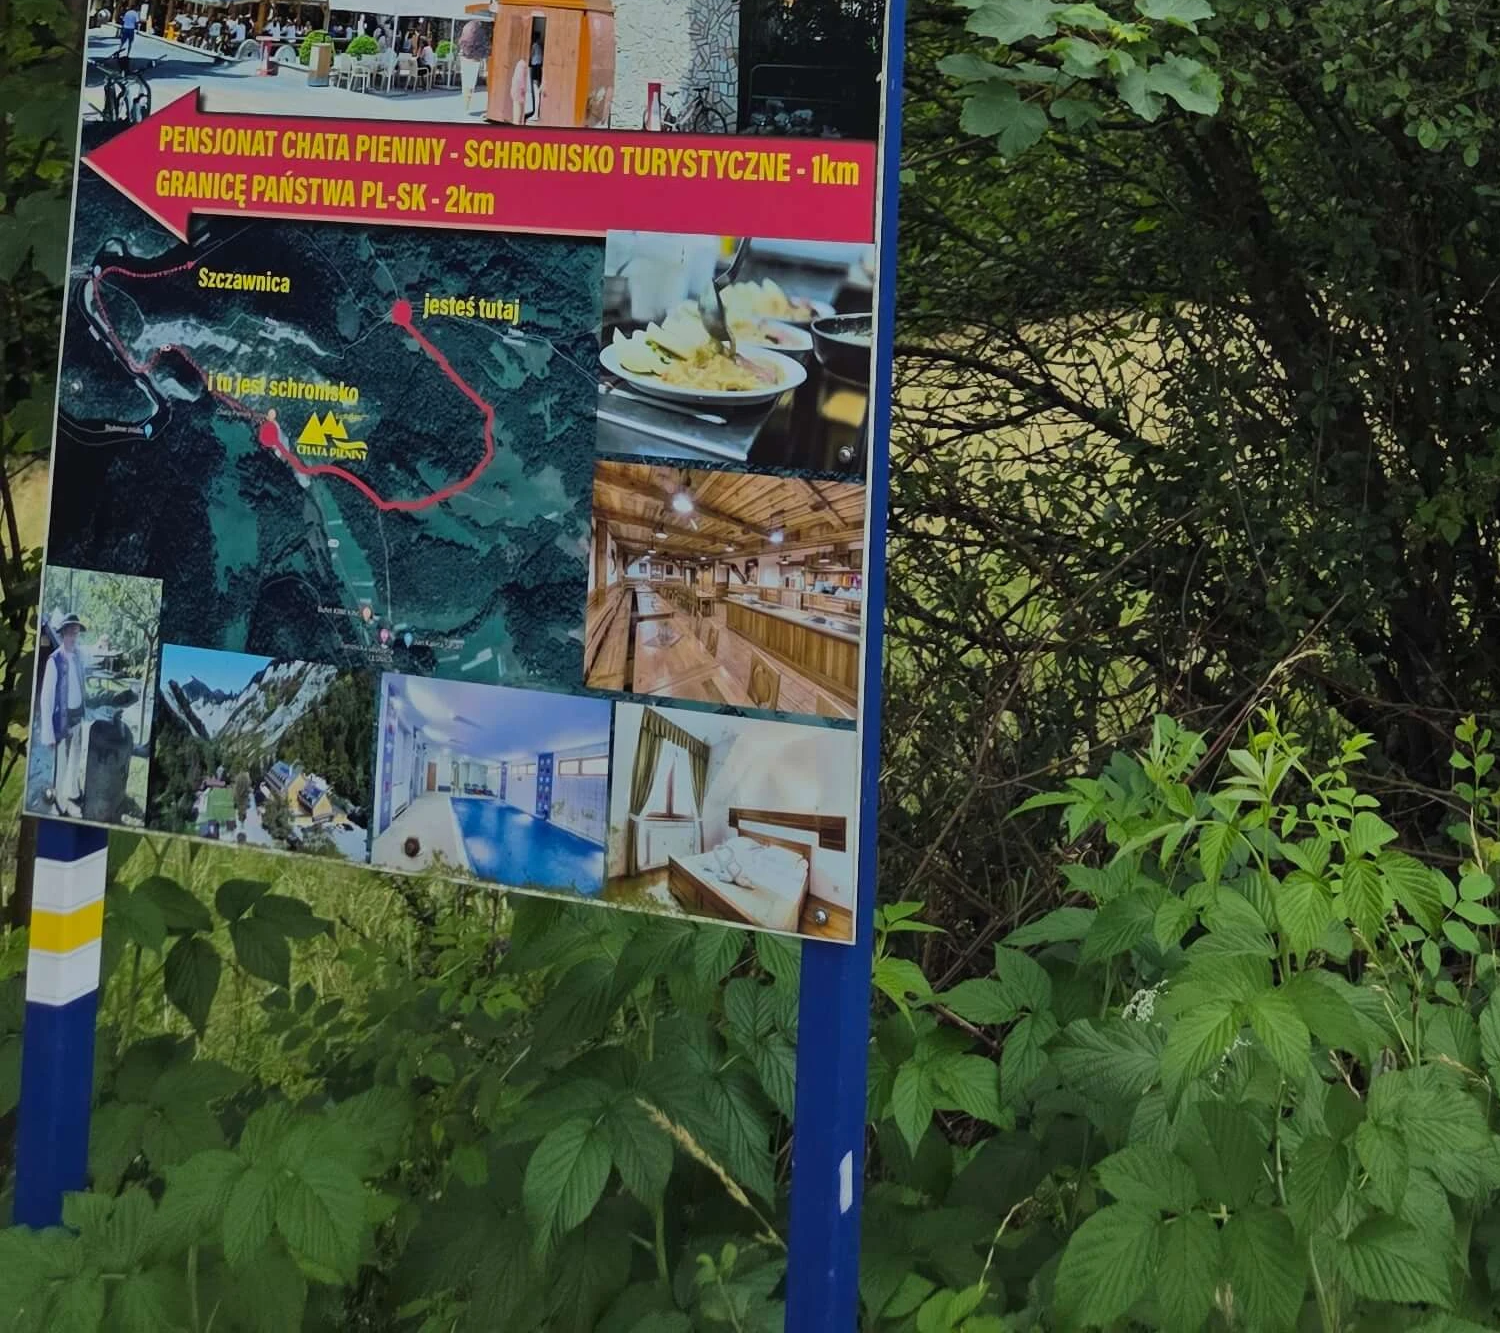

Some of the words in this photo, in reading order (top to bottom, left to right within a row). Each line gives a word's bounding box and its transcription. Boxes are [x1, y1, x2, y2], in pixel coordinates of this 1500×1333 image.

[158, 124, 278, 158] PENSJONAT
[281, 132, 350, 162] CHATA
[354, 134, 447, 166] PIENINY
[463, 139, 614, 174] SCHRONISKO
[620, 146, 791, 183] TURYSTYCZNE
[811, 154, 860, 186] 1km
[155, 169, 248, 208] GRANICĘ
[251, 170, 353, 207] PAŃSTWA
[361, 180, 427, 212] PL-SK
[445, 184, 495, 216] 2km
[198, 266, 291, 293] Szczawnica
[422, 292, 476, 319] jesteś
[479, 298, 520, 326] tutaj
[207, 370, 214, 392] i
[216, 372, 232, 393] tu
[234, 372, 267, 398] jest
[269, 377, 359, 405] schronisko
